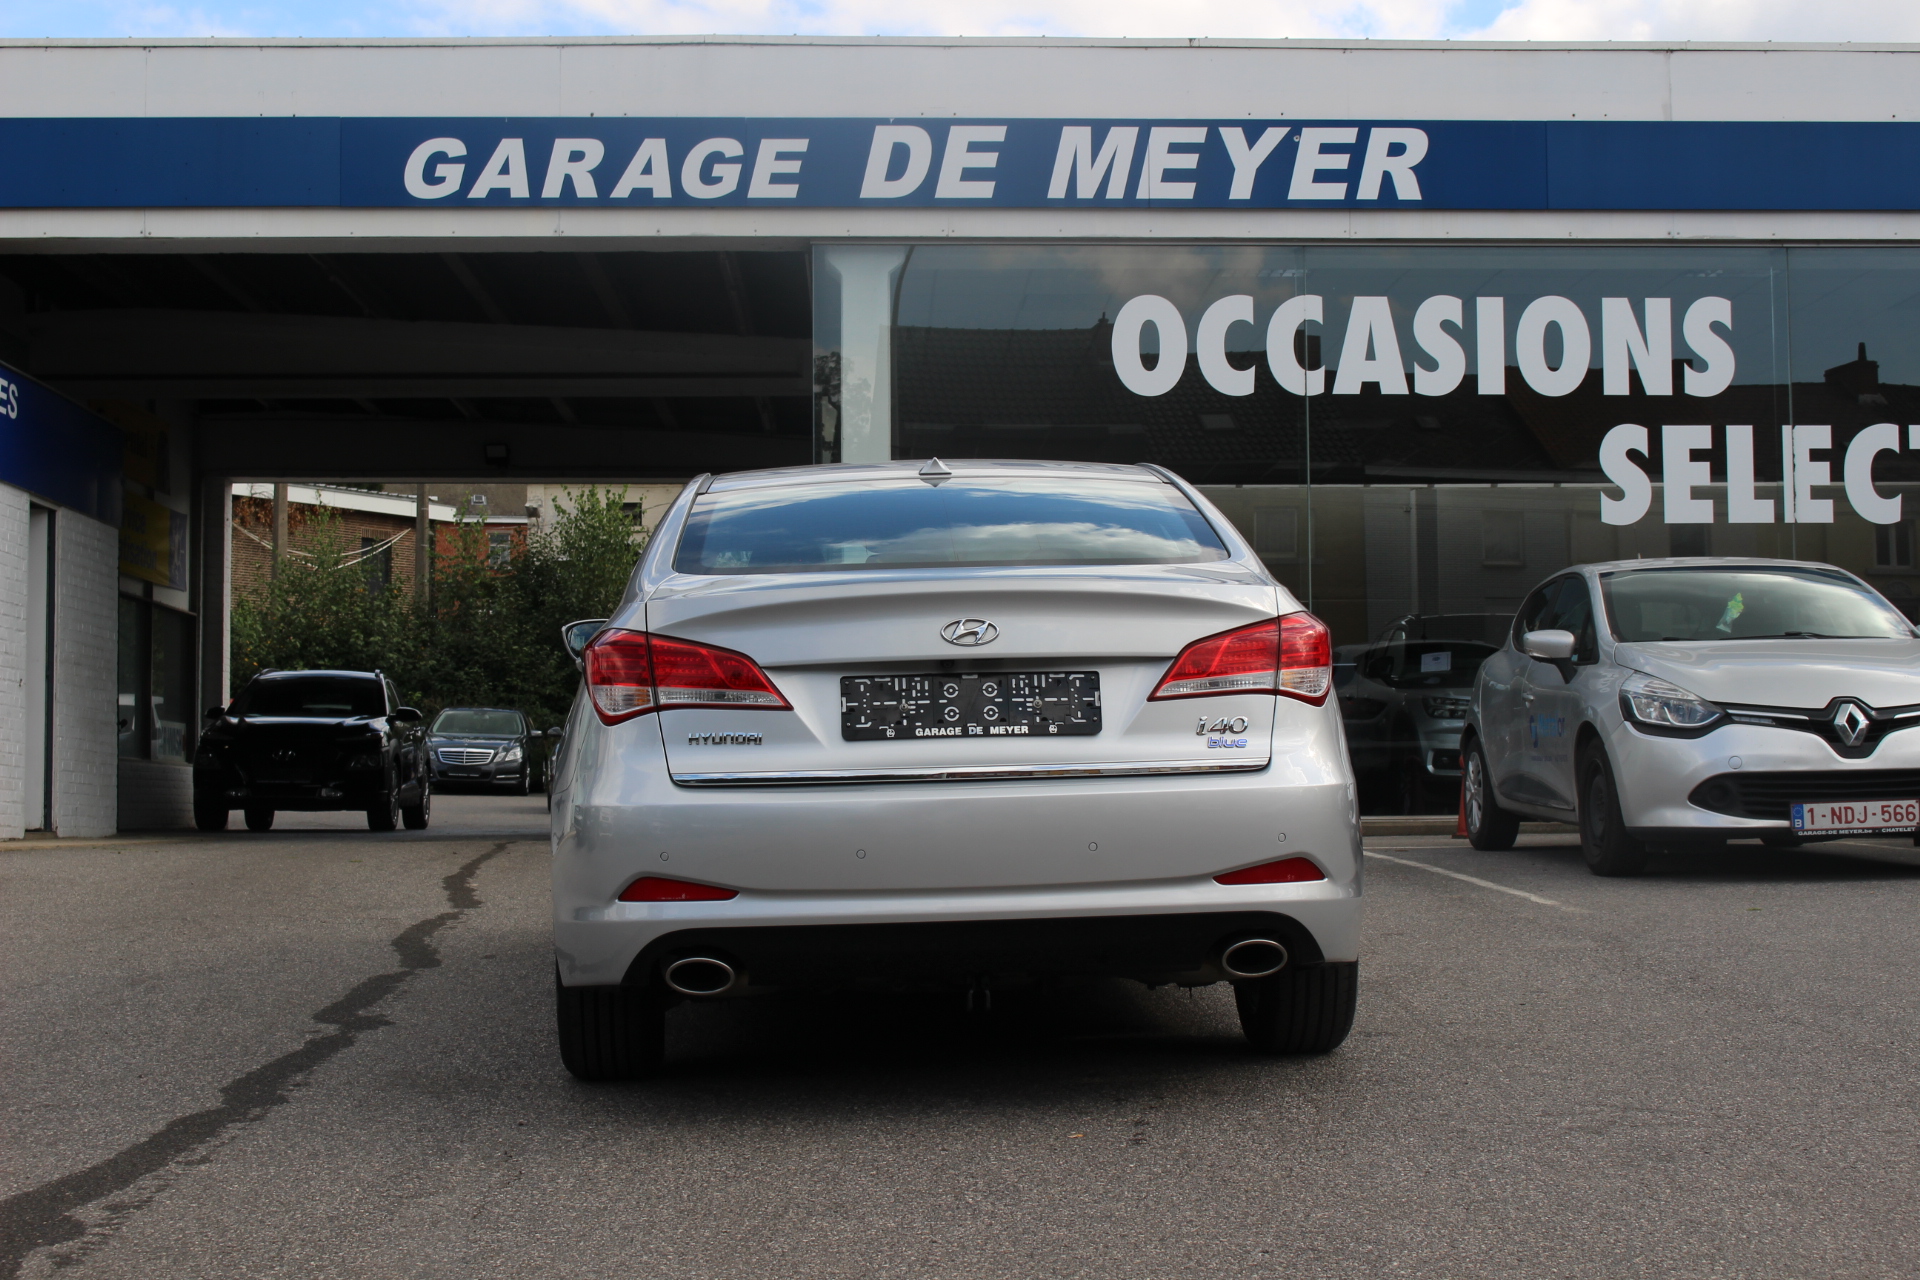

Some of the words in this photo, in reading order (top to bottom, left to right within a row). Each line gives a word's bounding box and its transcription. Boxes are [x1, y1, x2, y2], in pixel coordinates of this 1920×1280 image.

[404, 137, 809, 200] GARAGE
[859, 125, 1008, 199] DE
[1047, 126, 1430, 200] MEYER
[1111, 294, 1736, 398] OCCASIONS
[1599, 423, 1920, 526] SELEC
[915, 727, 962, 737] GARAGE
[968, 726, 984, 735] DE
[989, 725, 1029, 735] MEYER
[1196, 715, 1248, 736] i40
[688, 732, 763, 746] HYUNDAI
[1207, 735, 1248, 749] blue
[1794, 819, 1803, 828] B
[1807, 804, 1917, 826] 1-NDJ-566
